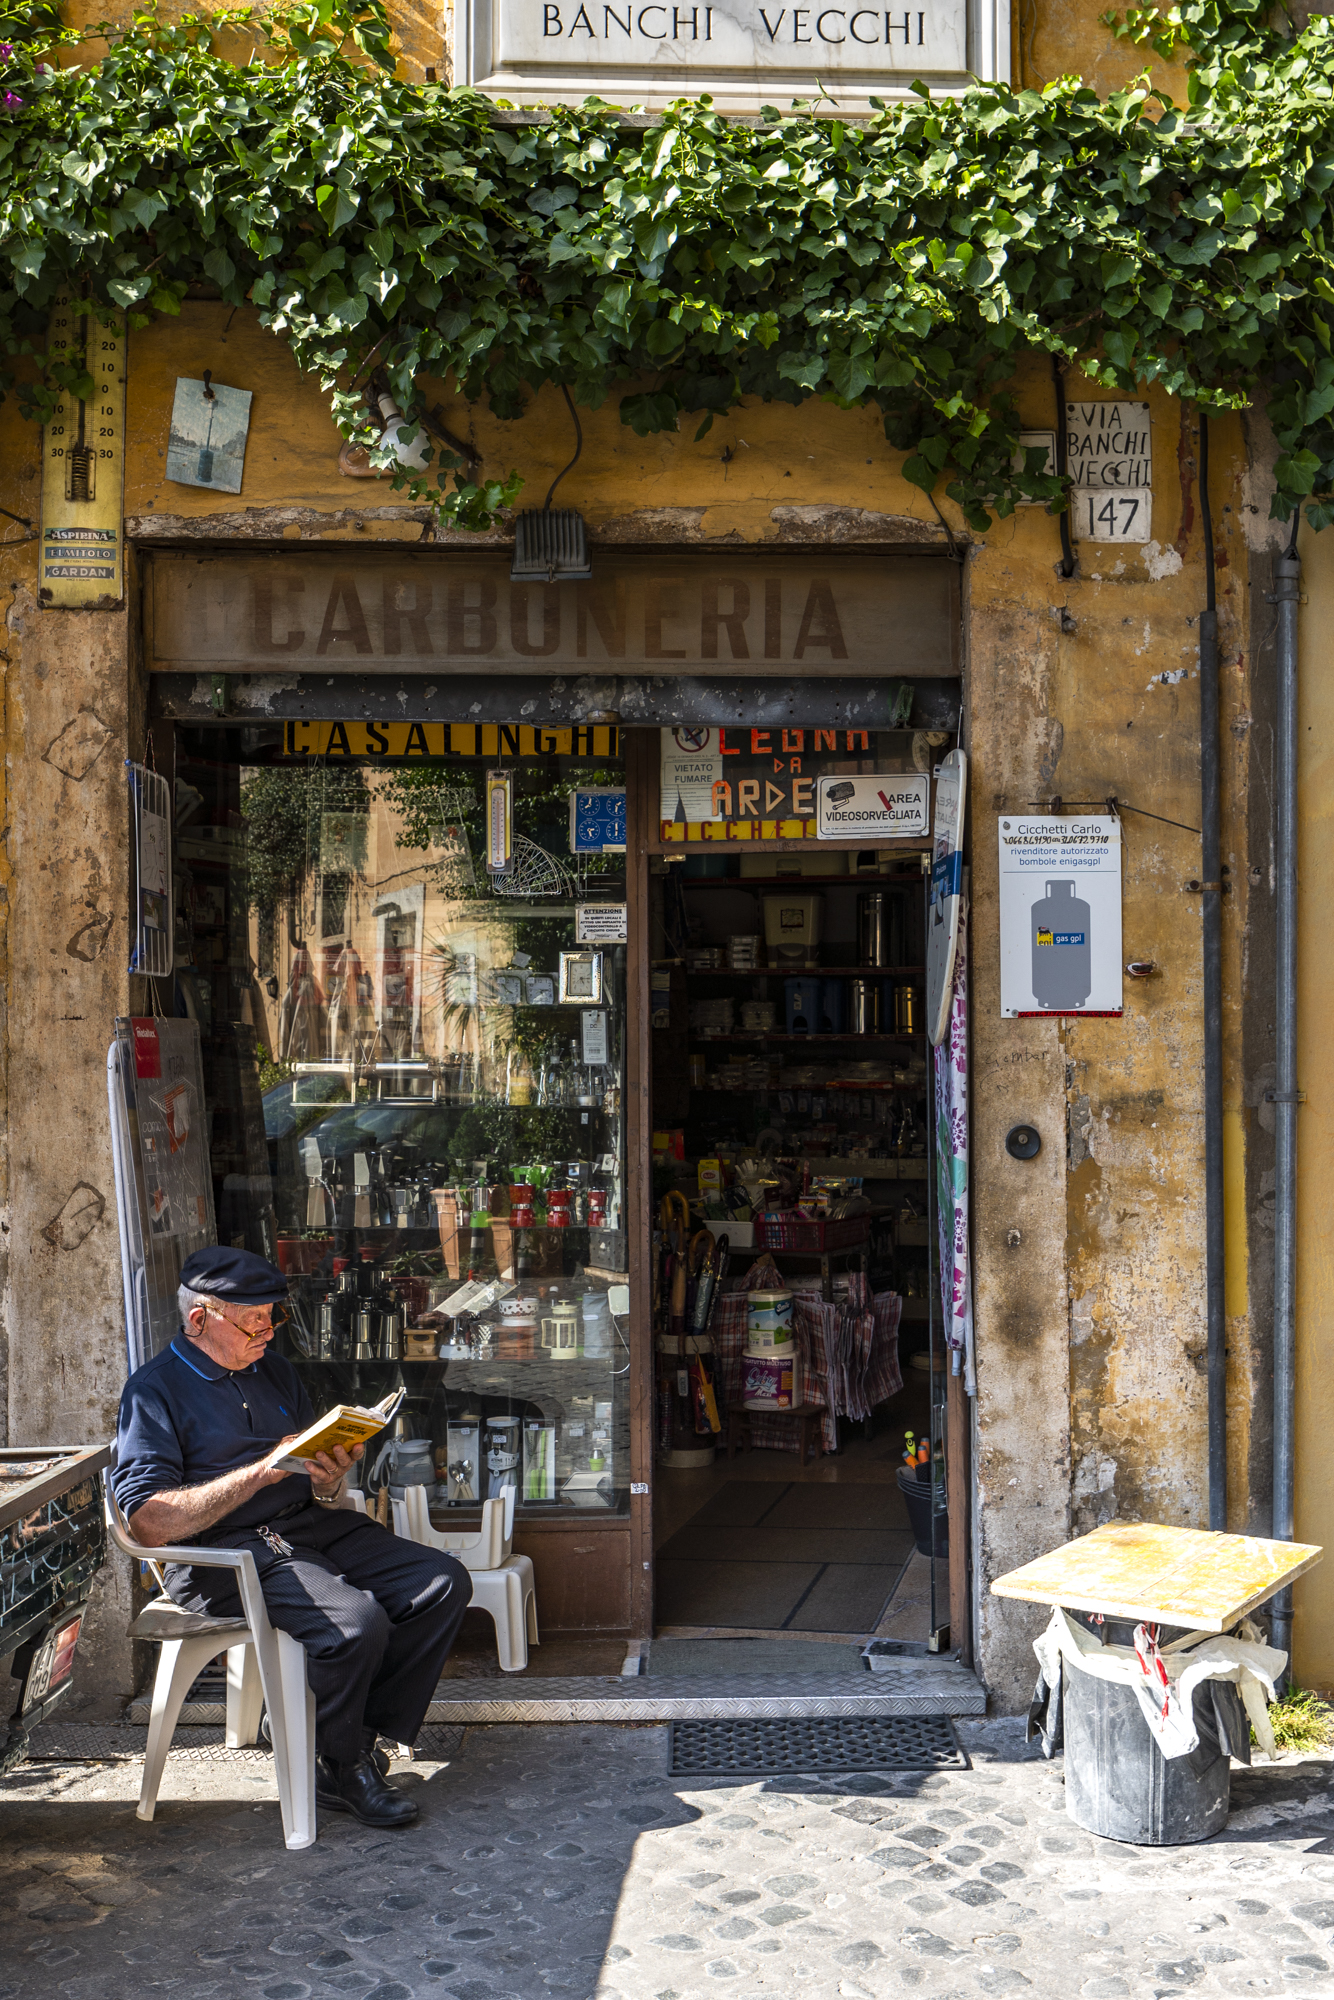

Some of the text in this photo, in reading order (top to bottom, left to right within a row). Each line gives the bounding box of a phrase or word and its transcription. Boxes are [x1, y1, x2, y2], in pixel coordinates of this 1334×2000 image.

[543, 3, 925, 46] BANCHI VECCHI
[55, 318, 67, 328] 30
[102, 342, 116, 351] 20
[102, 362, 114, 372] 10
[102, 384, 109, 394] 0
[52, 405, 64, 414] 10
[101, 406, 114, 416] 10
[1080, 403, 1122, 429] VIA
[51, 426, 64, 435] 20
[100, 428, 114, 437] 20
[1067, 430, 1148, 457] BANCHI
[51, 448, 64, 458] 30
[100, 450, 113, 458] 30
[1070, 458, 1151, 487] VECCHI
[1087, 498, 1140, 536] 147
[51, 530, 109, 541] ASPIRINA
[50, 548, 111, 558] ELMITOLO
[52, 567, 106, 577] GARDAN
[254, 573, 850, 661] CARBONERIA
[287, 721, 619, 756] CASALINGHI
[719, 728, 869, 755] LEGNA
[674, 764, 713, 772] VIETATO
[774, 756, 802, 774] DA
[674, 774, 712, 783] FUMARE
[711, 777, 815, 817] ARDE
[888, 793, 922, 804] AREA
[825, 810, 922, 821] VIDEOSORVEGLIATA
[660, 819, 811, 842] CICCHET
[1018, 824, 1102, 834] Cicchetti Carlo
[1019, 858, 1101, 866] bombole enigasgpl
[1038, 938, 1052, 946] eni
[1055, 934, 1082, 944] gas gpl
